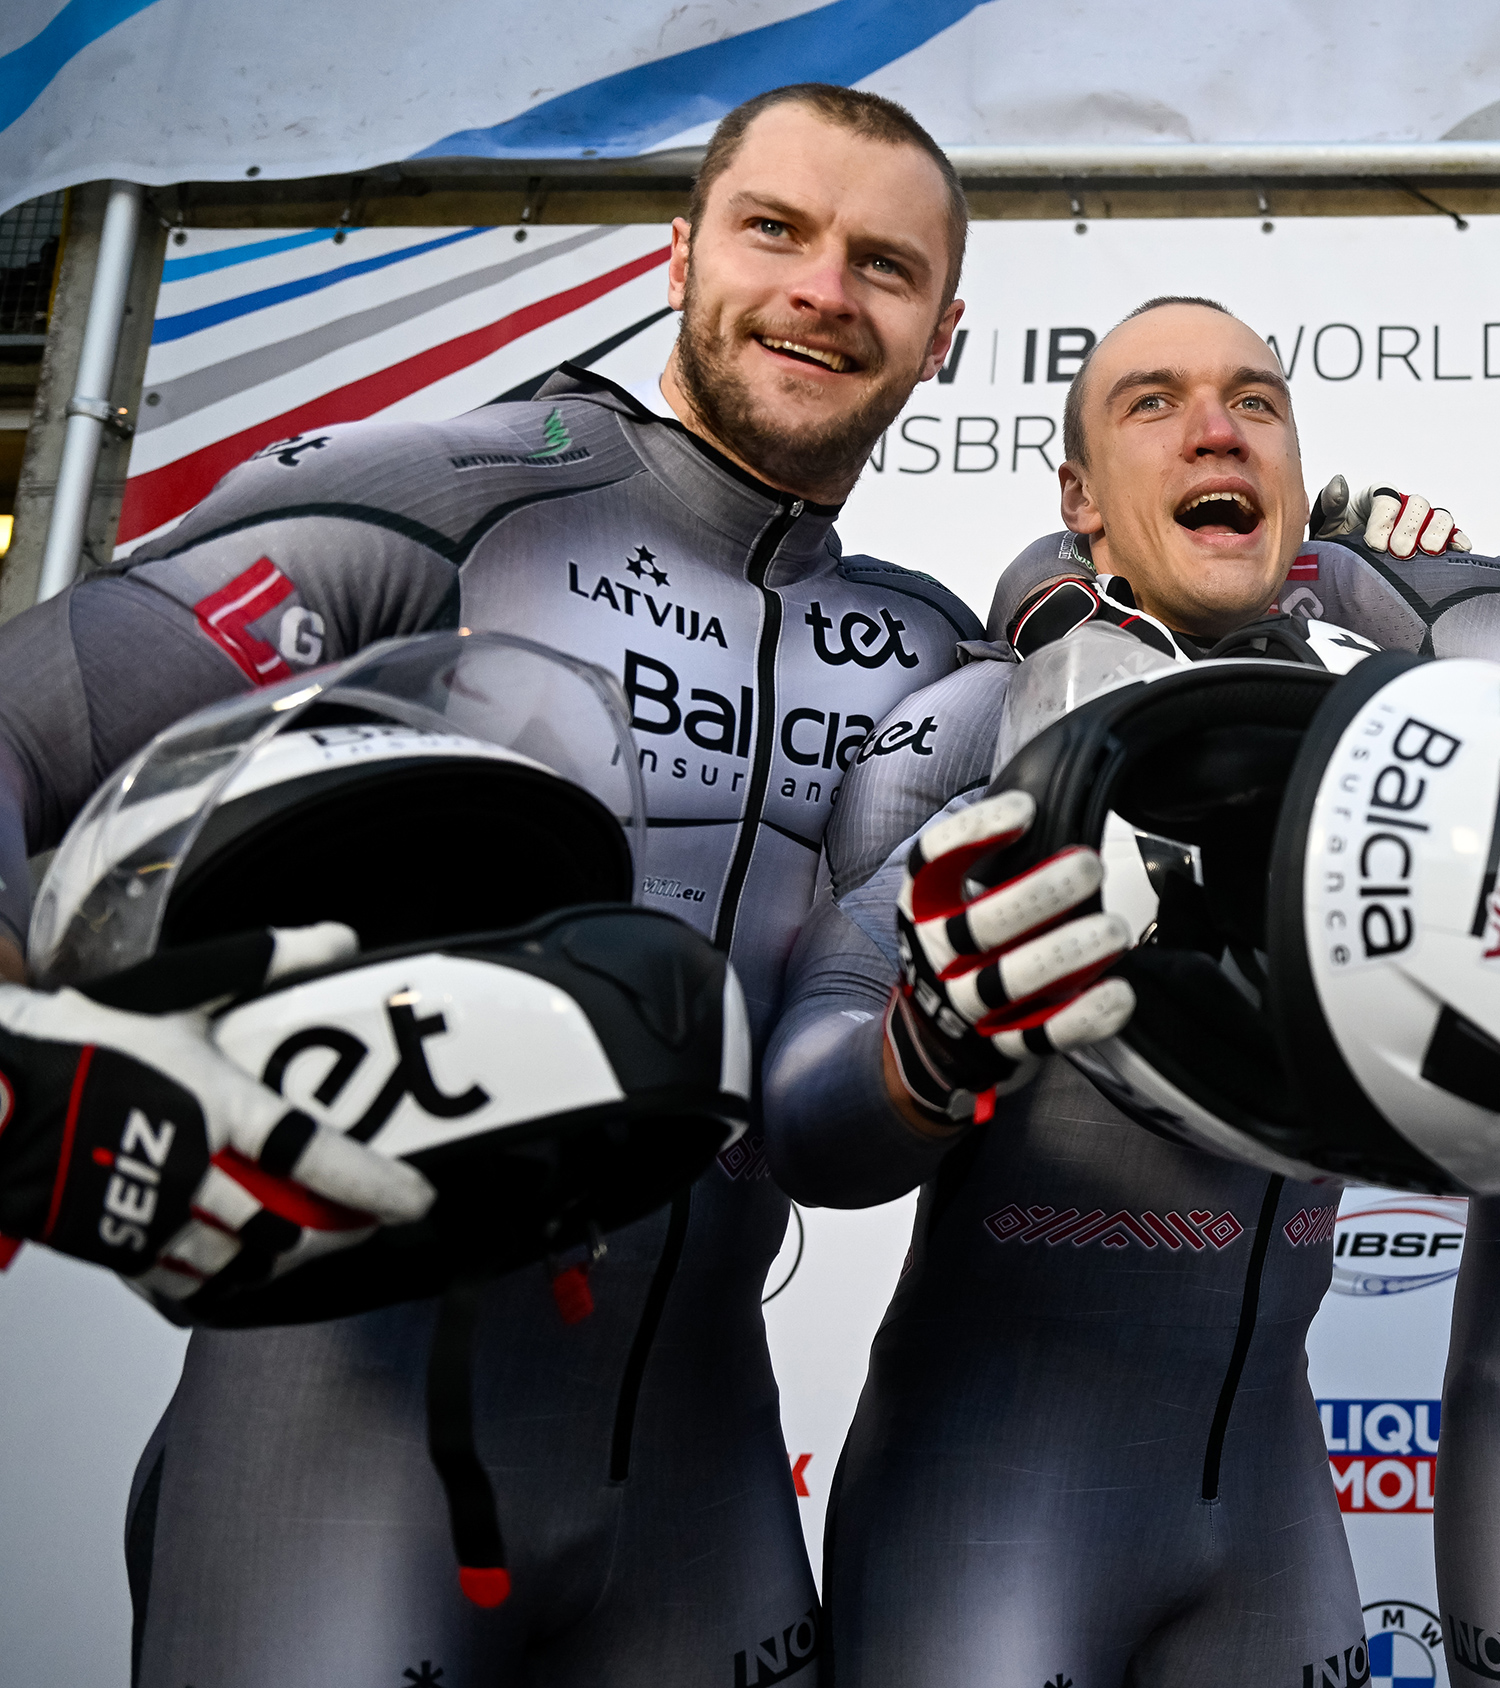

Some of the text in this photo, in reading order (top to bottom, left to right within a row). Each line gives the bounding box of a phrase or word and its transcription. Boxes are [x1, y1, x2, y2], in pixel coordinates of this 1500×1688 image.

[568, 562, 729, 650] LATVIJA
[804, 601, 920, 669] tet
[1326, 703, 1395, 966] insurance
[1359, 717, 1463, 959] Balcia
[261, 984, 491, 1144] et
[1334, 1232, 1465, 1258] IBSF
[1319, 1403, 1442, 1455] LIQU
[1328, 1459, 1438, 1511] MOL
